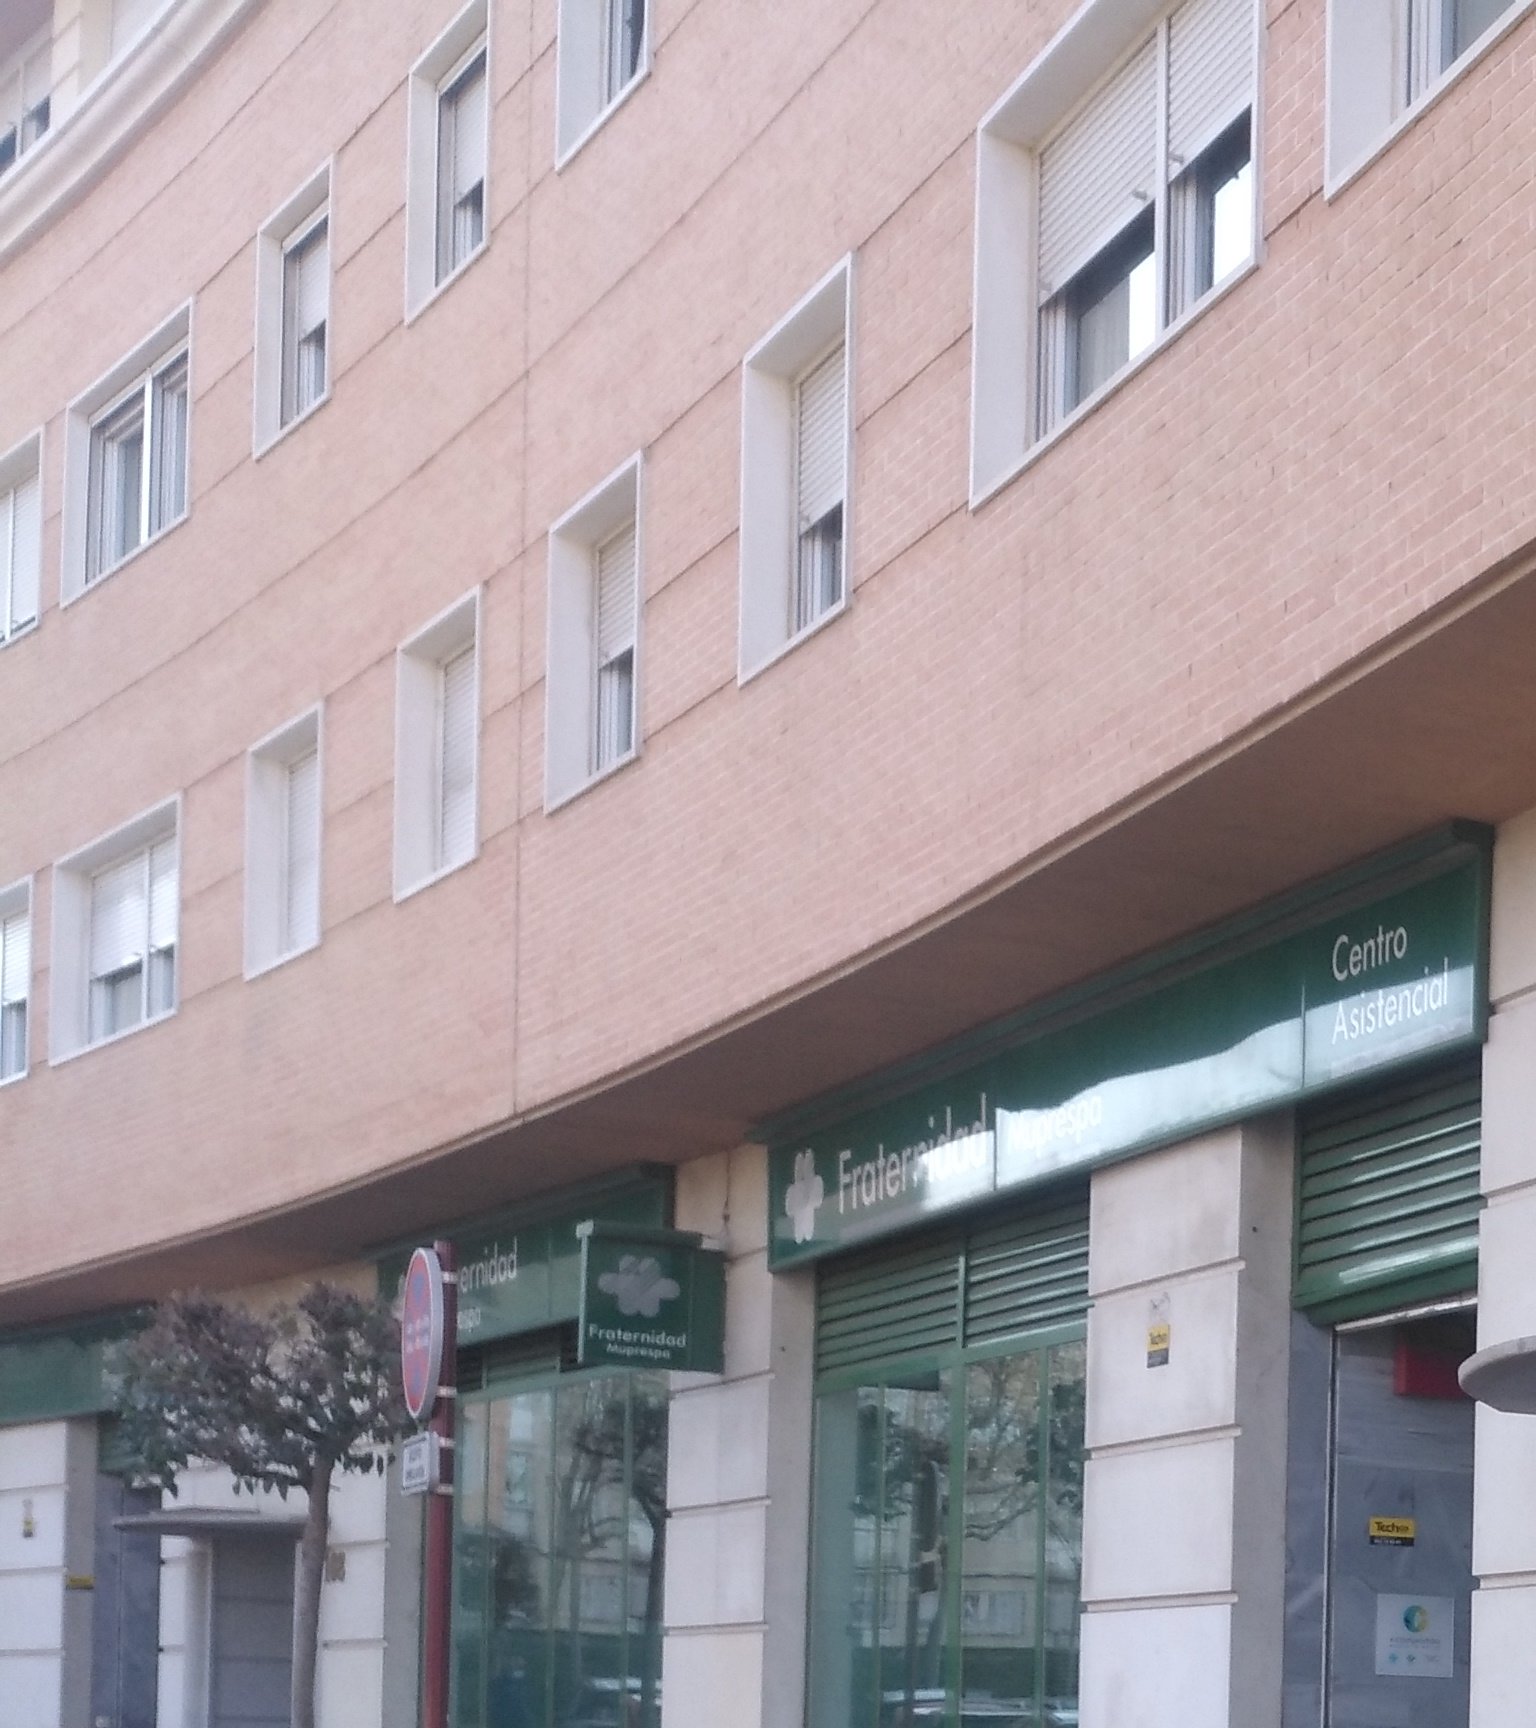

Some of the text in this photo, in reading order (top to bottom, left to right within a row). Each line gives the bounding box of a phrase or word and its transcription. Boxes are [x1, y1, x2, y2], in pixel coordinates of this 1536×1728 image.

[1332, 925, 1408, 982] Centro
[1331, 956, 1449, 1045] Asistencial
[838, 1091, 987, 1215] Fraternidad
[457, 1235, 518, 1294] ernidad
[588, 1322, 687, 1348] Fraternidad
[606, 1341, 671, 1360] Muprespa
